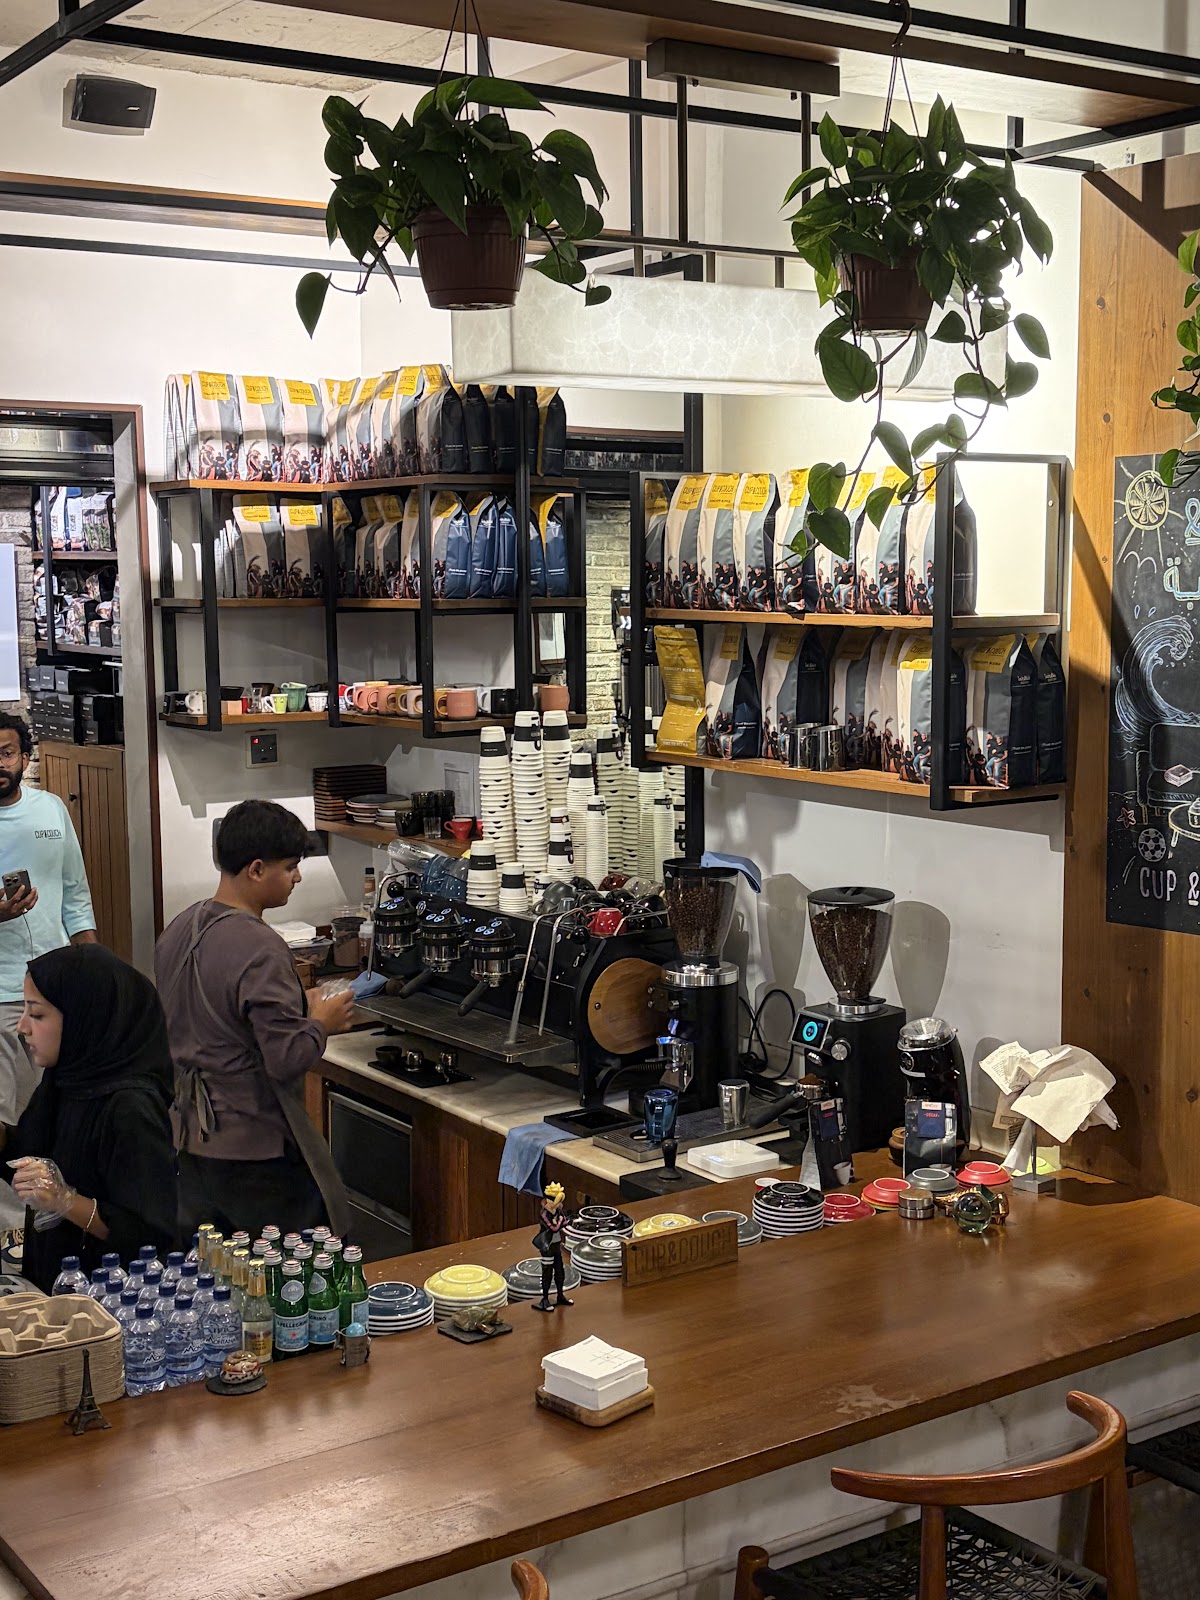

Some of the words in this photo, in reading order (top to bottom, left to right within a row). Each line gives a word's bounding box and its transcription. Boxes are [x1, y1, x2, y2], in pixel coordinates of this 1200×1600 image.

[1140, 866, 1177, 901] CUP
[1188, 871, 1200, 906] &
[634, 1226, 732, 1275] CUP&COUCH
